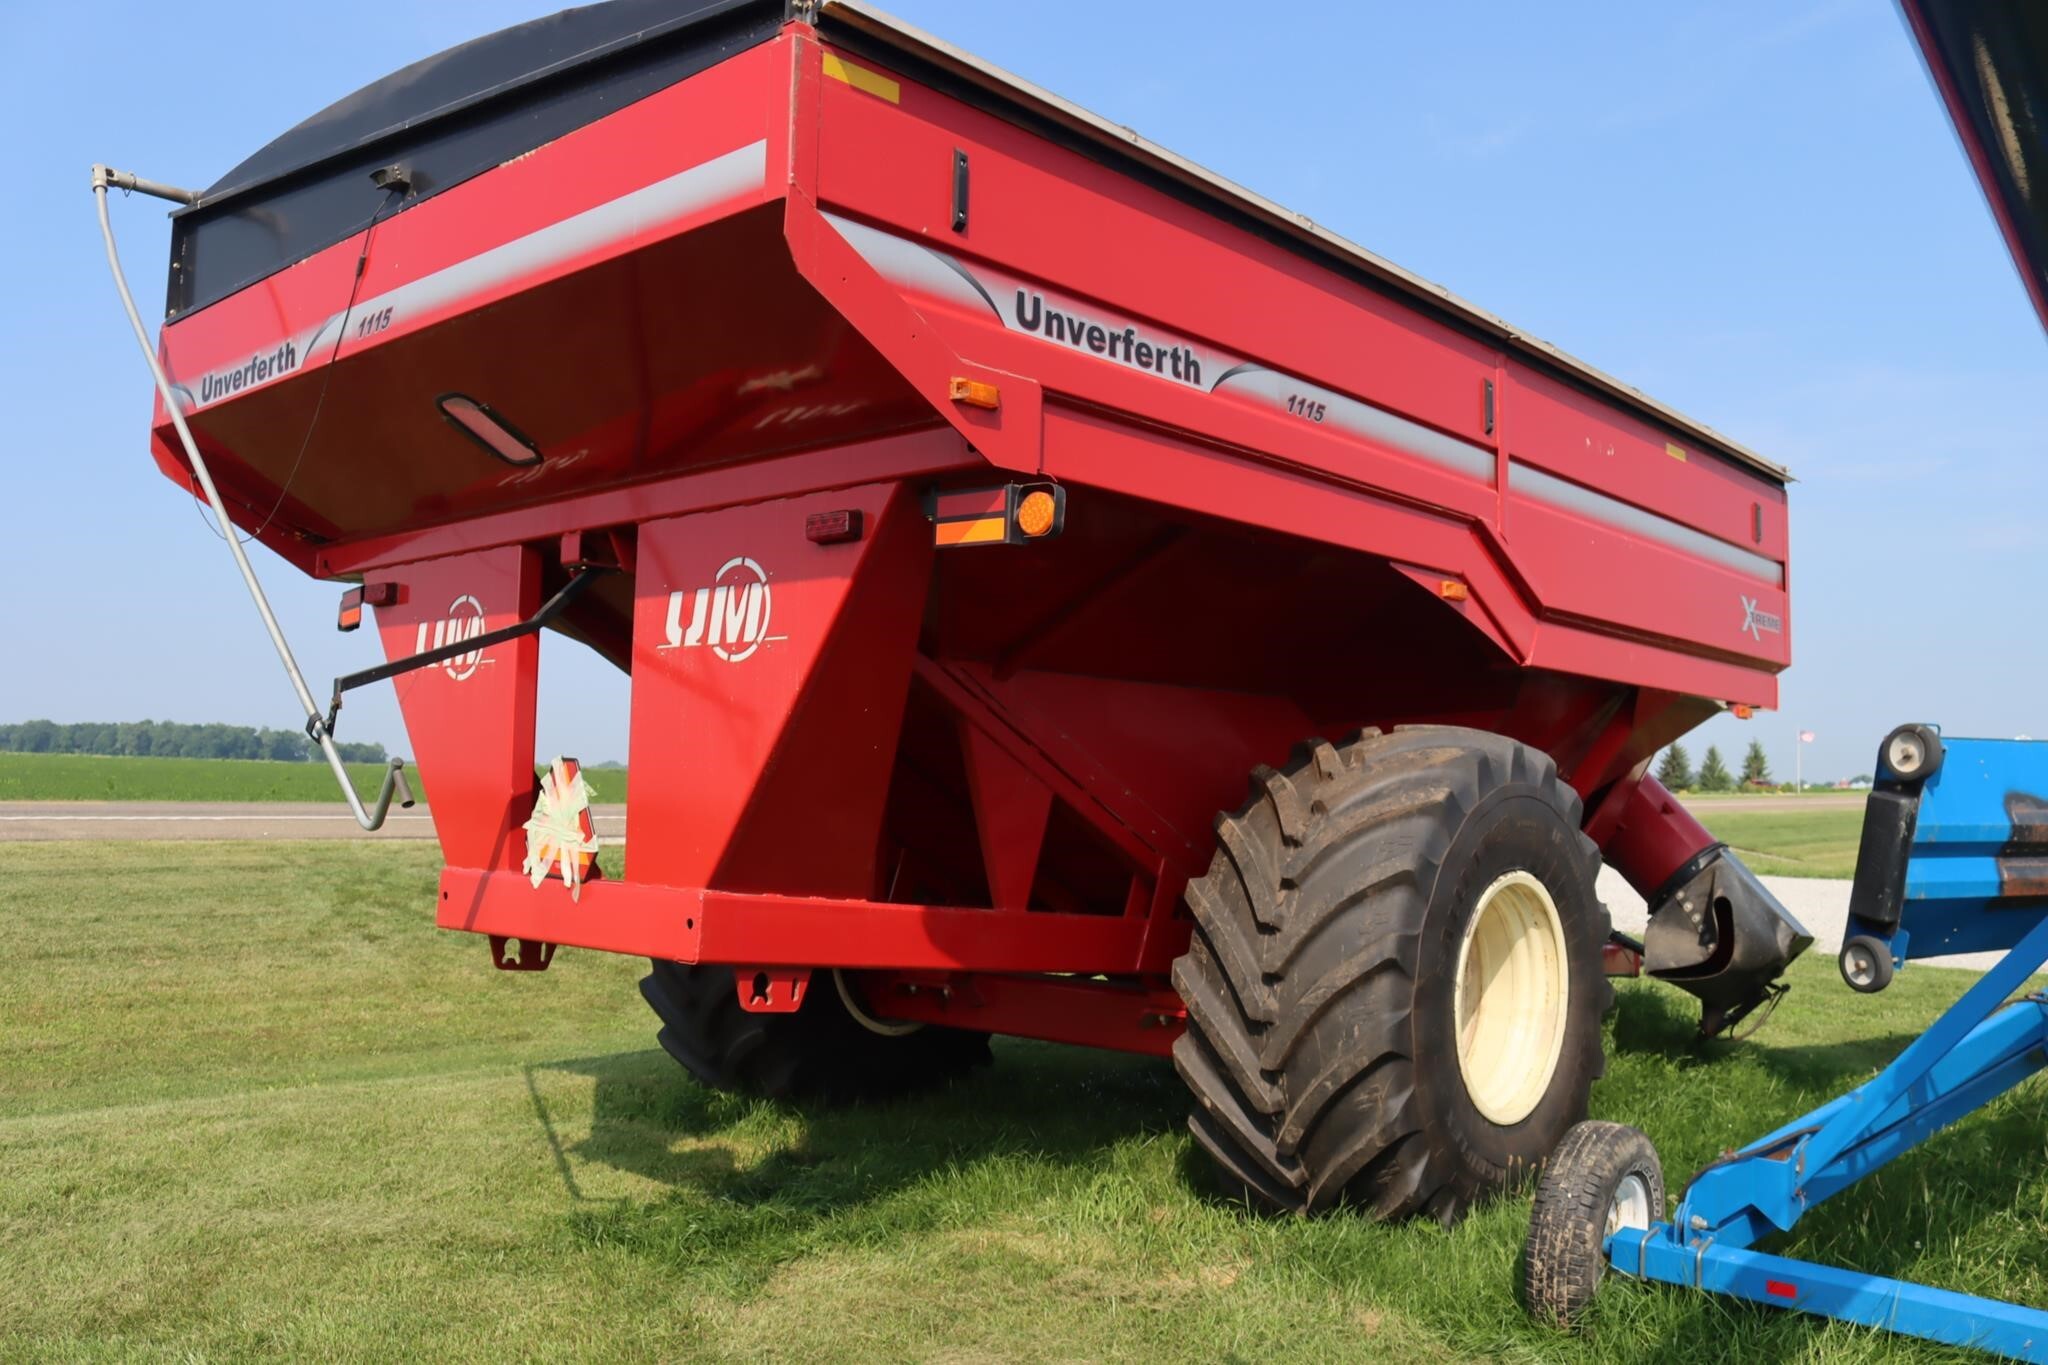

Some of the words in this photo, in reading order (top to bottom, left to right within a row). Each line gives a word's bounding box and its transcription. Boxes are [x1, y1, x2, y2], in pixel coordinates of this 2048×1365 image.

[357, 306, 394, 339] 1115
[1014, 290, 1202, 386] Unverferth
[201, 342, 296, 402] Unverferth
[1286, 394, 1327, 423] 1115
